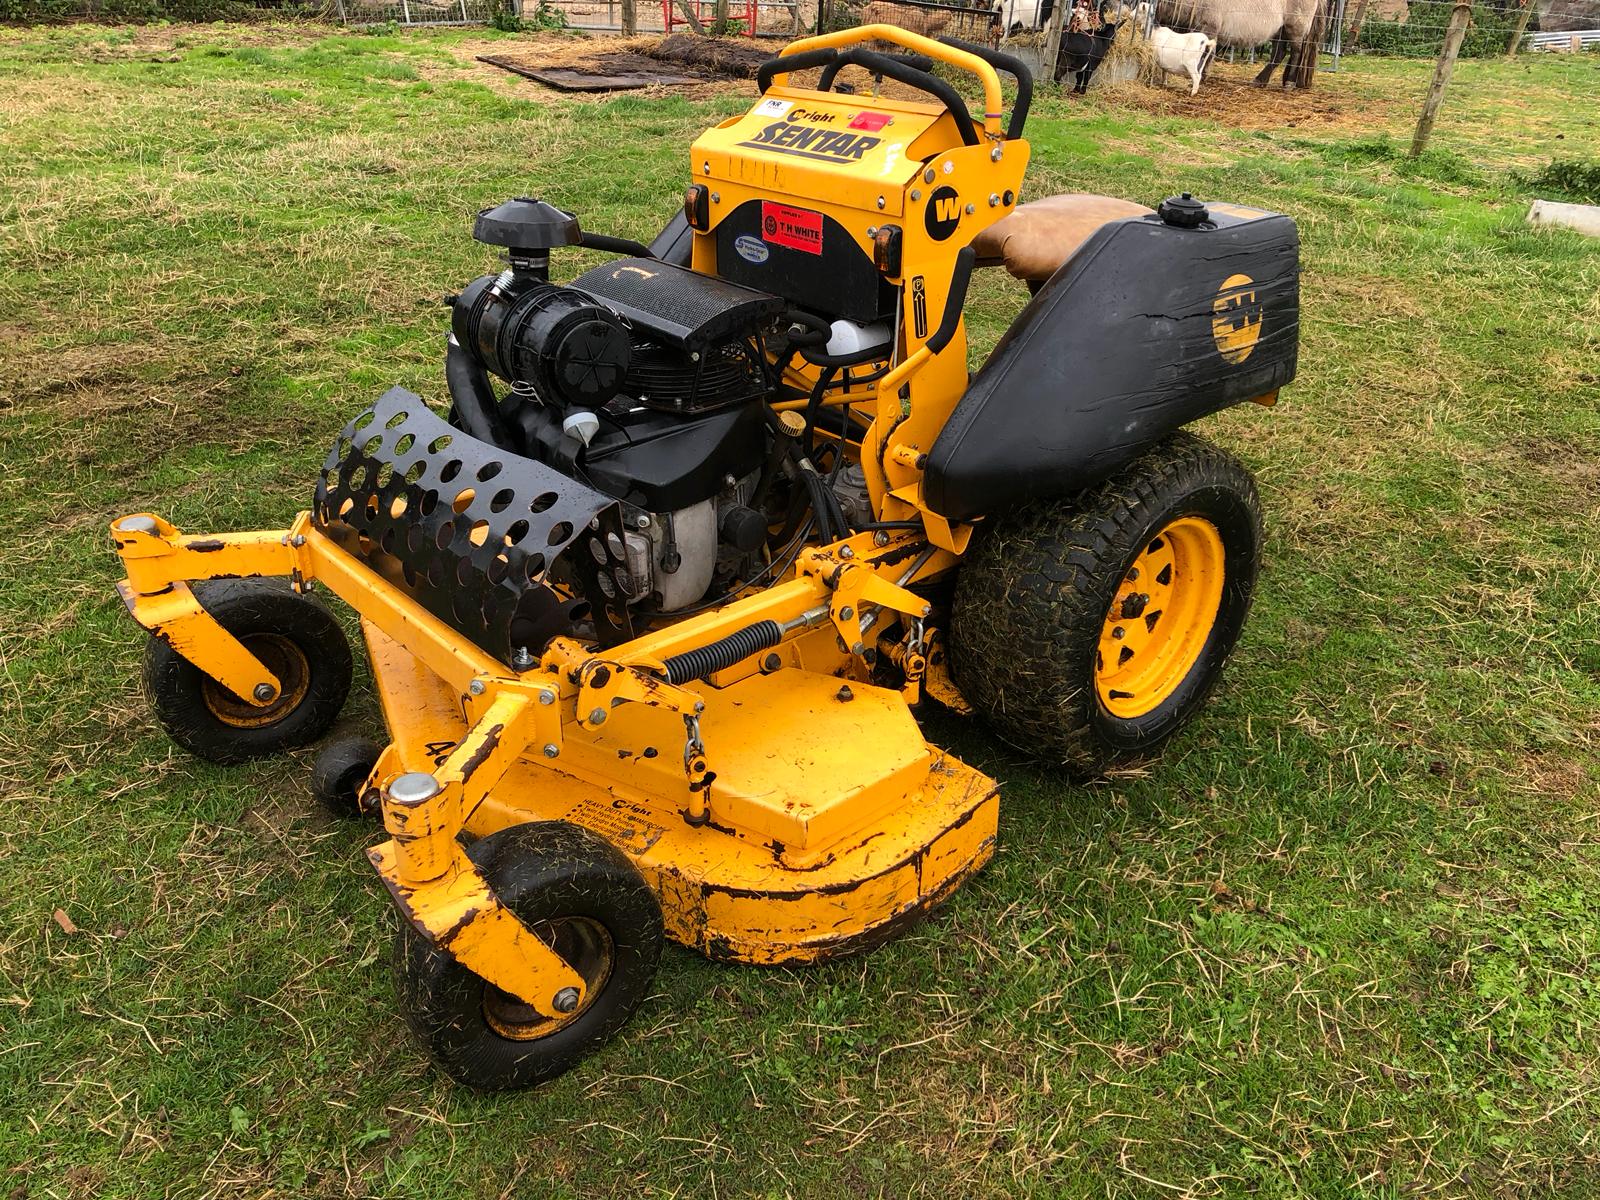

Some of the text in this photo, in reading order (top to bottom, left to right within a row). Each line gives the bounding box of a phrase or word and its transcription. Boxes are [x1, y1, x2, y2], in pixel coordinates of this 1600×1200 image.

[751, 121, 881, 159] SENTAR
[935, 197, 961, 222] W
[780, 222, 785, 231] T
[786, 223, 792, 233] H
[794, 225, 820, 240] WHITE
[583, 799, 604, 809] HEAVY
[604, 807, 622, 815] DUTY
[583, 805, 597, 813] Twin
[598, 811, 614, 820] Hydro
[578, 809, 591, 818] Twin
[592, 815, 609, 825] Hydro
